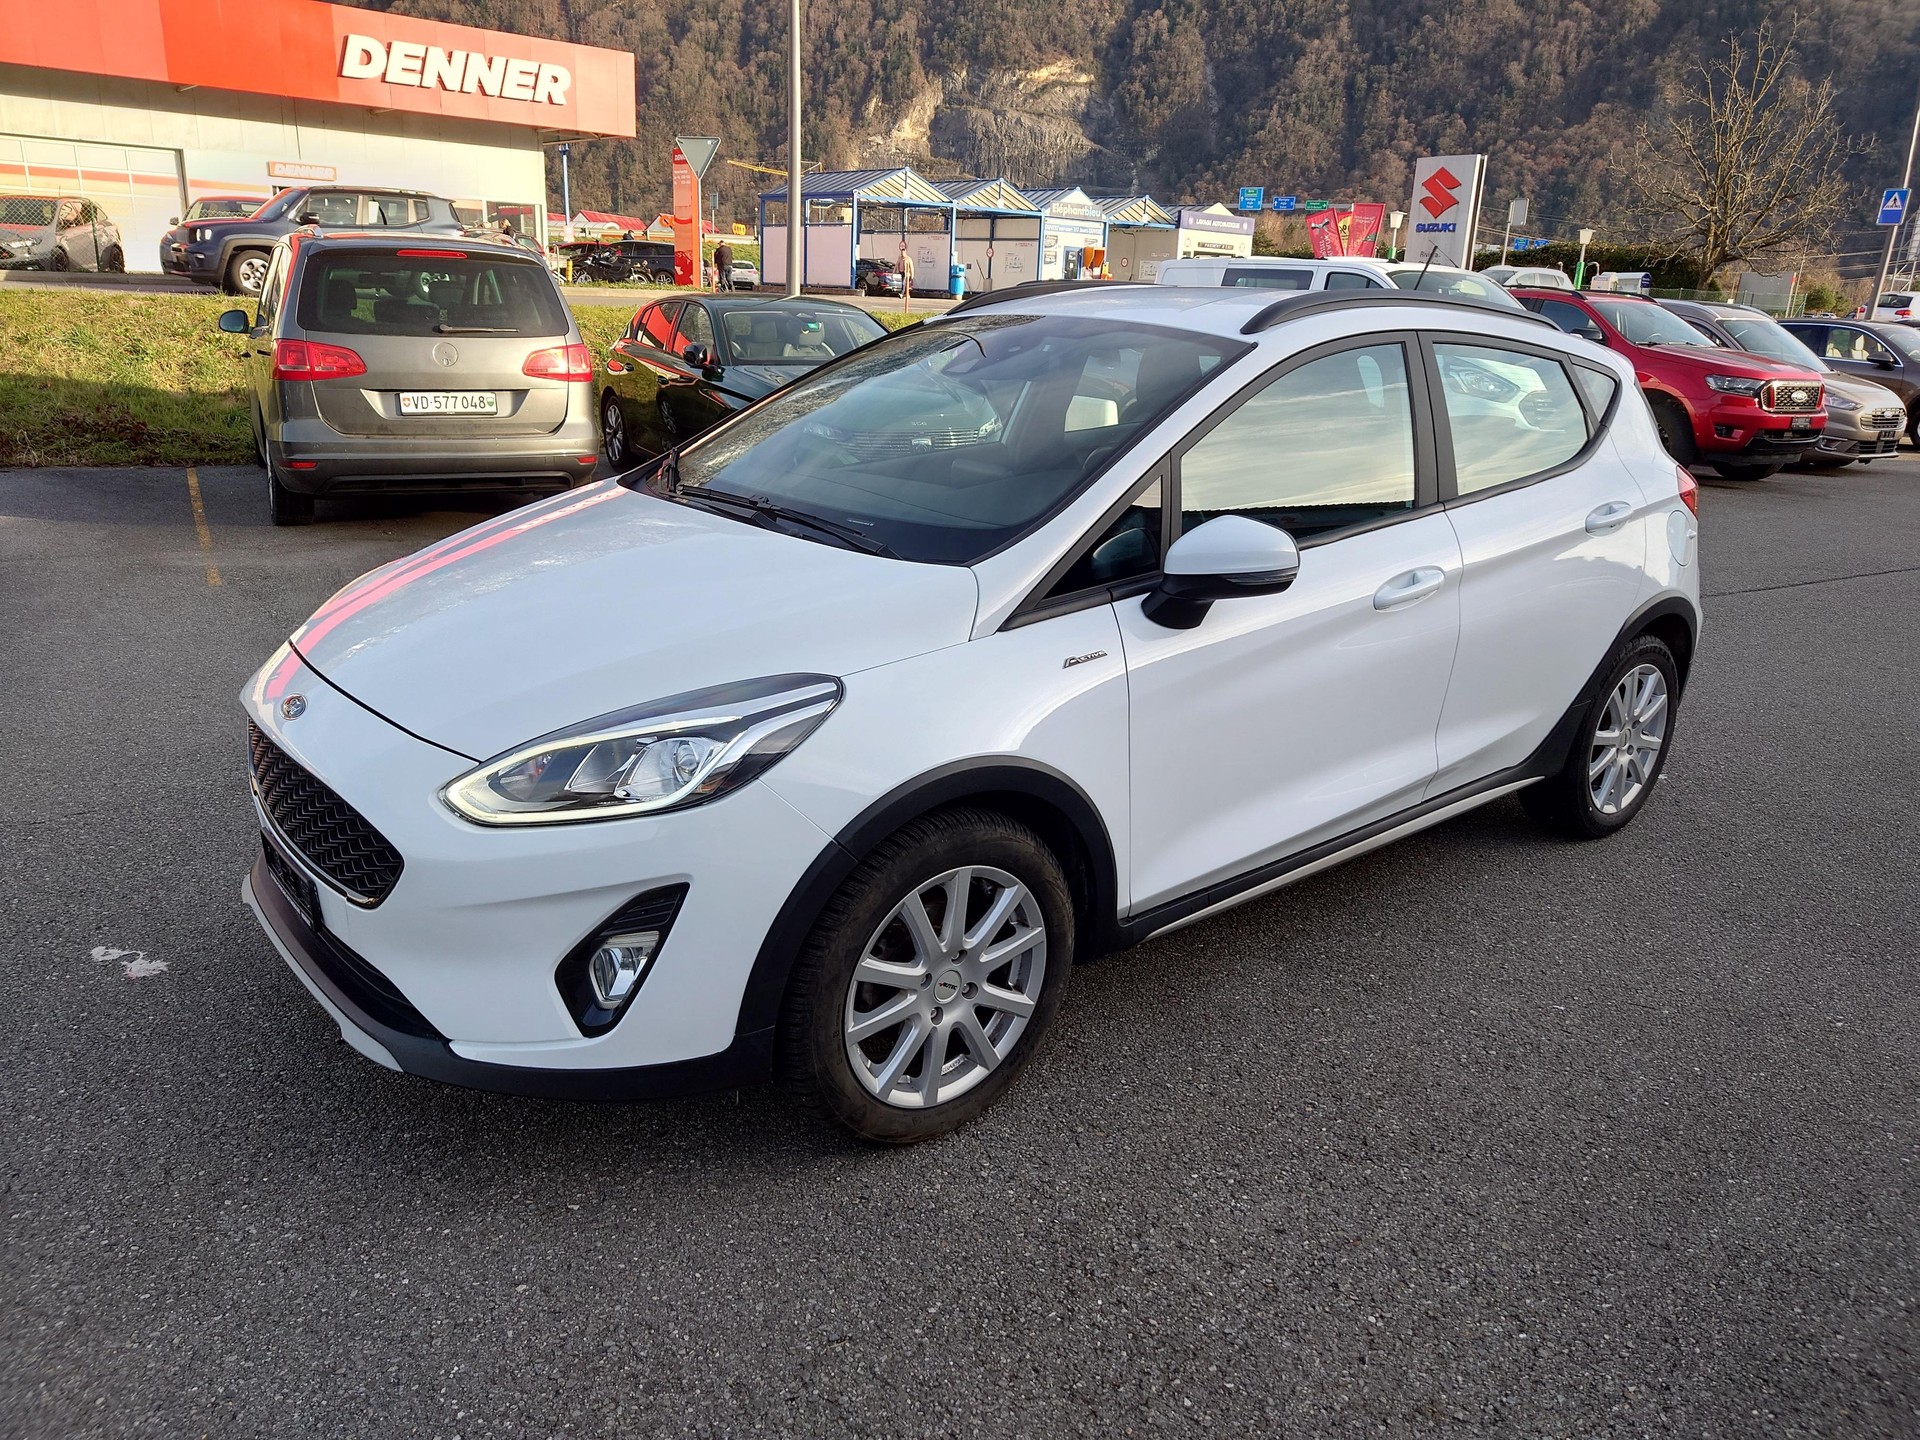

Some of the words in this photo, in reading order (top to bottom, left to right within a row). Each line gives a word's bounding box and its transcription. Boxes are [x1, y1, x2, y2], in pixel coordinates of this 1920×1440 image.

[338, 34, 572, 105] DENNER
[274, 163, 334, 179] DENNER
[1416, 223, 1456, 232] SUZUKI
